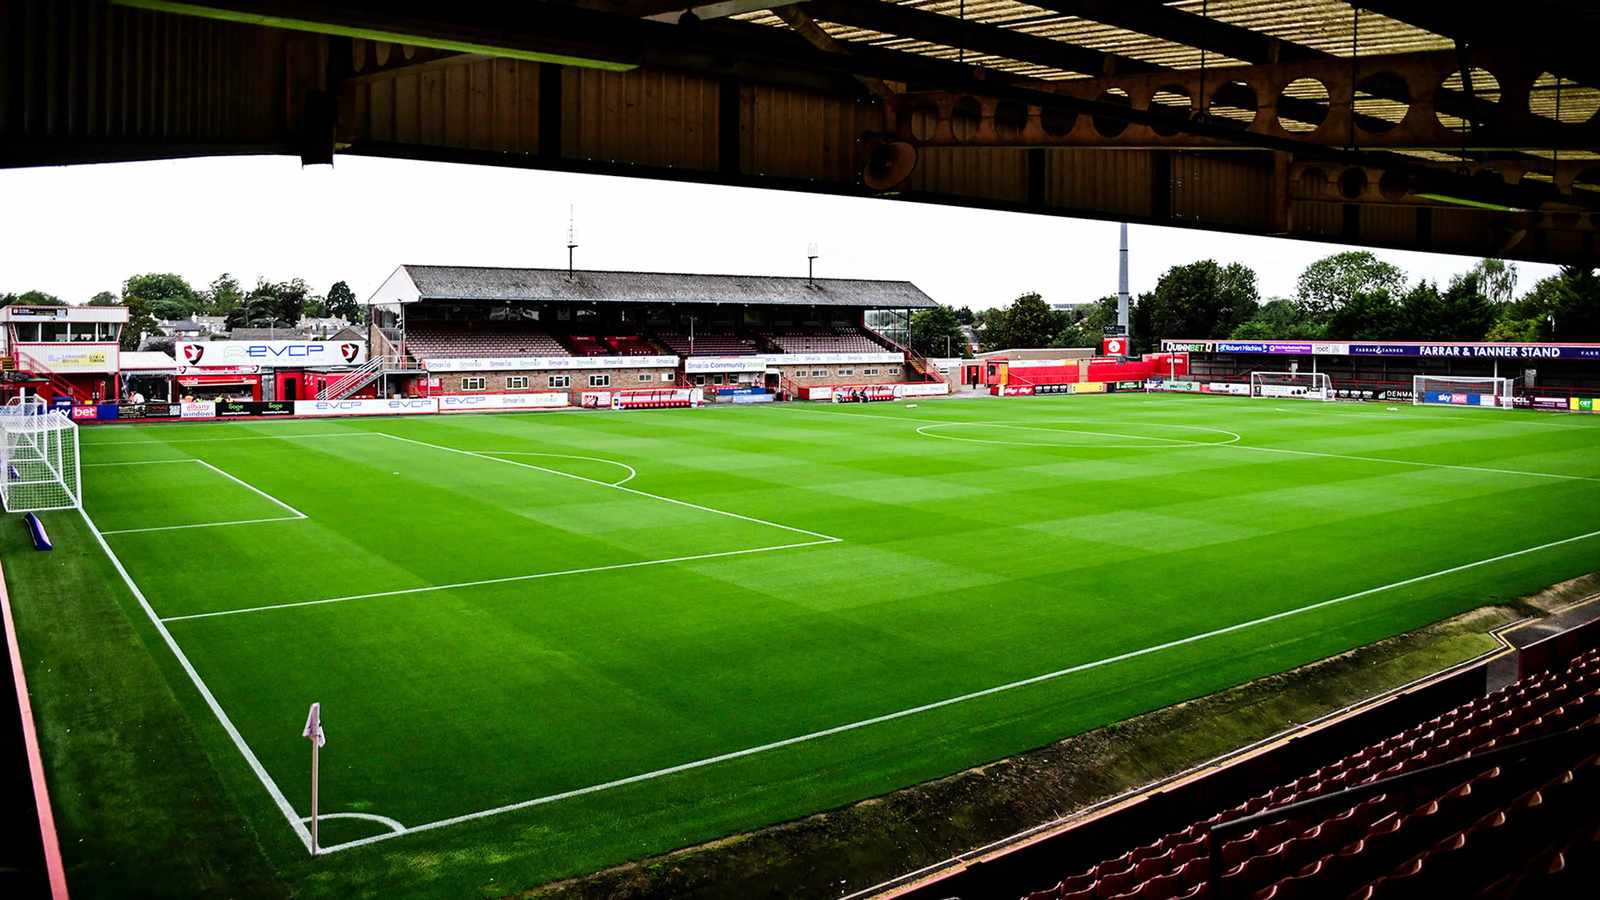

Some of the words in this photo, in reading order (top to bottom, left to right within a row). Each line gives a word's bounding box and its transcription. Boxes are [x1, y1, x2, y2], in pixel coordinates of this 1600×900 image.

[1166, 343, 1205, 352] QUINNBET
[1420, 346, 1460, 356] FARRAR
[1462, 347, 1471, 356] &
[1473, 347, 1518, 357] TANNER
[1521, 347, 1561, 357] STAND
[710, 361, 746, 370] Community
[1438, 393, 1452, 402] sky
[74, 406, 96, 417] bet
